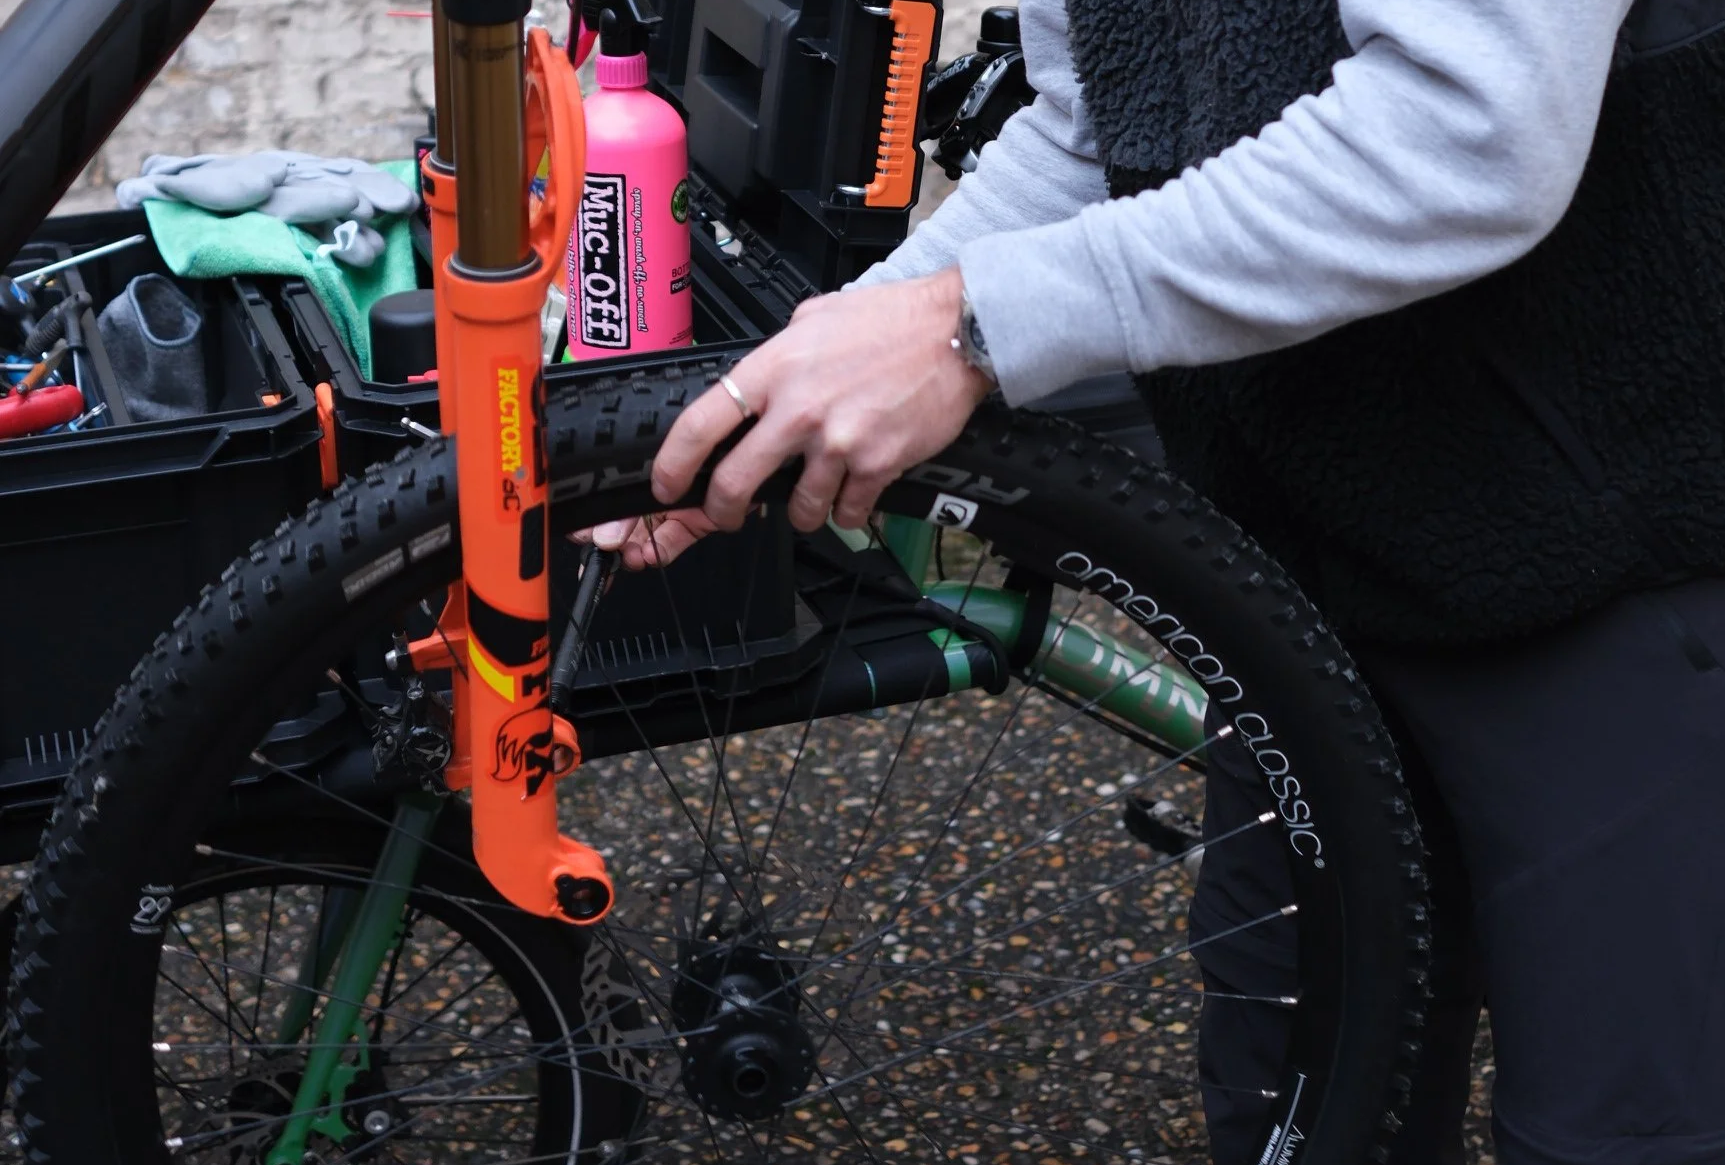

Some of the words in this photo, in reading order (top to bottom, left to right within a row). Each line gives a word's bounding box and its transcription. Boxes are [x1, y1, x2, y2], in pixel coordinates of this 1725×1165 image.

[631, 188, 643, 218] spray
[632, 220, 642, 236] on,
[567, 249, 576, 282] bike
[634, 237, 646, 263] wash
[636, 285, 645, 298] no
[569, 284, 578, 340] cleaner
[637, 300, 649, 332] sweat!
[498, 368, 522, 472] FACTORY
[1055, 551, 1243, 703] american
[133, 896, 172, 924] 29
